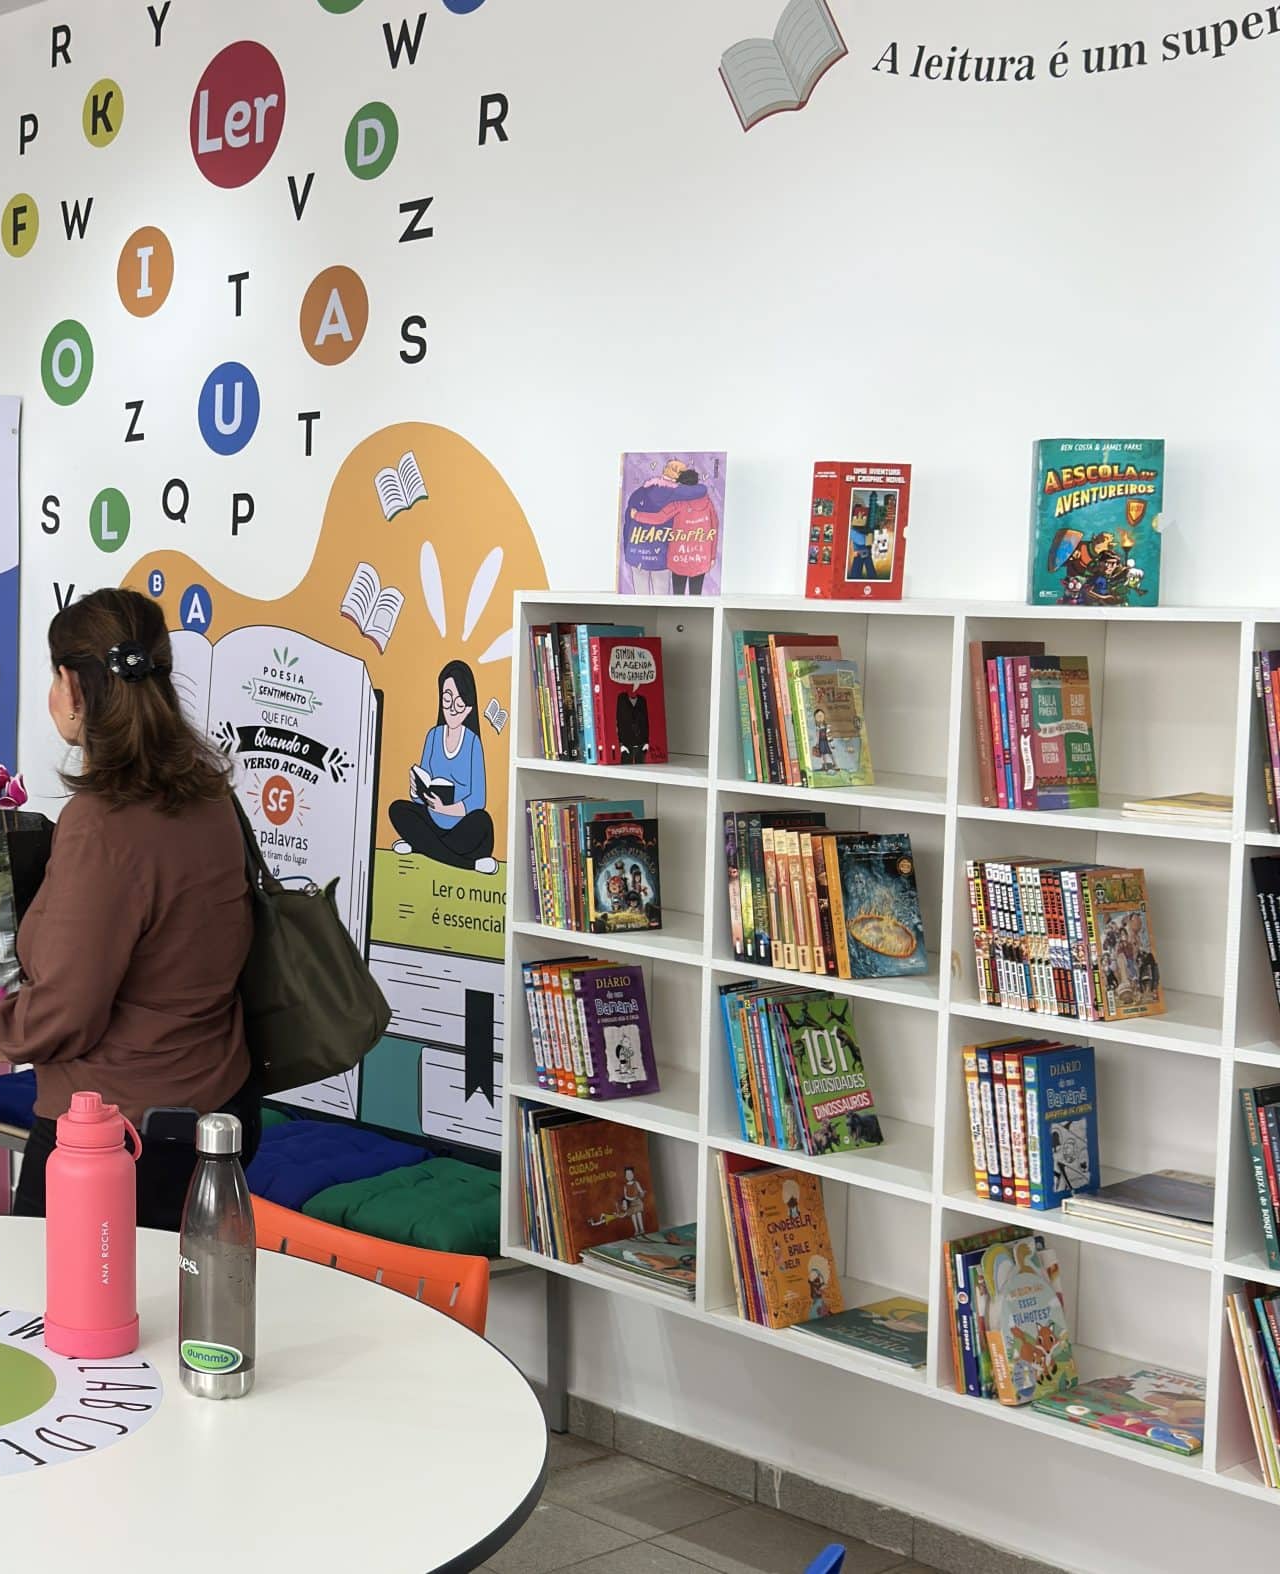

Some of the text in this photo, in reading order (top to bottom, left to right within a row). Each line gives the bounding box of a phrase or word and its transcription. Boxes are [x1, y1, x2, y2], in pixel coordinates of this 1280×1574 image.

[147, 0, 171, 47] Y
[382, 12, 427, 69] W
[51, 25, 72, 68] R
[872, 42, 899, 75] A
[910, 46, 1035, 82] leitura
[1049, 41, 1069, 78] é
[1082, 41, 1148, 74] um
[91, 91, 114, 136] K
[197, 89, 280, 155] Ler
[478, 92, 509, 145] R
[19, 113, 39, 156] P
[356, 118, 387, 167] D
[287, 172, 315, 221] V
[12, 205, 28, 246] F
[60, 197, 94, 241] W
[398, 196, 434, 243] Z
[136, 245, 154, 299] I
[227, 271, 250, 317] T
[314, 287, 354, 346] A
[399, 315, 428, 364] S
[51, 337, 84, 389] O
[124, 399, 145, 443] Z
[214, 382, 244, 435] U
[297, 411, 322, 457] T
[1061, 443, 1073, 451] BEN
[1074, 443, 1093, 451] COSTA
[1102, 443, 1122, 451] JAMES
[1124, 443, 1142, 451] PARKS
[1045, 471, 1061, 493] A
[1062, 465, 1137, 486] ESCOLA
[41, 495, 61, 535] S
[162, 478, 190, 524] Q
[231, 492, 255, 536] P
[1055, 484, 1155, 517] AVENTUREIROS
[101, 500, 119, 541] L
[630, 526, 717, 545] HEARTSTOPPER
[678, 543, 704, 554] ALICE
[152, 574, 163, 592] B
[186, 592, 207, 624] A
[615, 648, 635, 660] SIMON
[615, 661, 652, 670] A AGENDA
[263, 666, 305, 685] POESIA
[258, 685, 307, 705] SENTIMENTO
[261, 710, 299, 728] QUE FICA
[254, 727, 310, 755] Quando o
[243, 757, 319, 785] VERSO ACABA
[266, 786, 293, 813] SE
[260, 827, 309, 851] palavras
[267, 850, 283, 861] tiram
[283, 852, 292, 862] do
[292, 853, 308, 866] lugar
[432, 879, 454, 899] Ler
[456, 886, 466, 900] o
[431, 906, 506, 935] é essencial
[596, 976, 631, 990] DIÁRIO
[595, 999, 639, 1016] Banana
[801, 1026, 848, 1076] 101
[803, 1073, 866, 1096] CURIOSIDADES
[1049, 1061, 1082, 1078] DIÁRIO
[814, 1092, 870, 1120] DINOSSAUROS
[1047, 1087, 1088, 1109] Banana
[767, 1214, 813, 1235] CINDERELA
[100, 1220, 110, 1285] ANA ROCHA
[787, 1241, 811, 1257] BAILE
